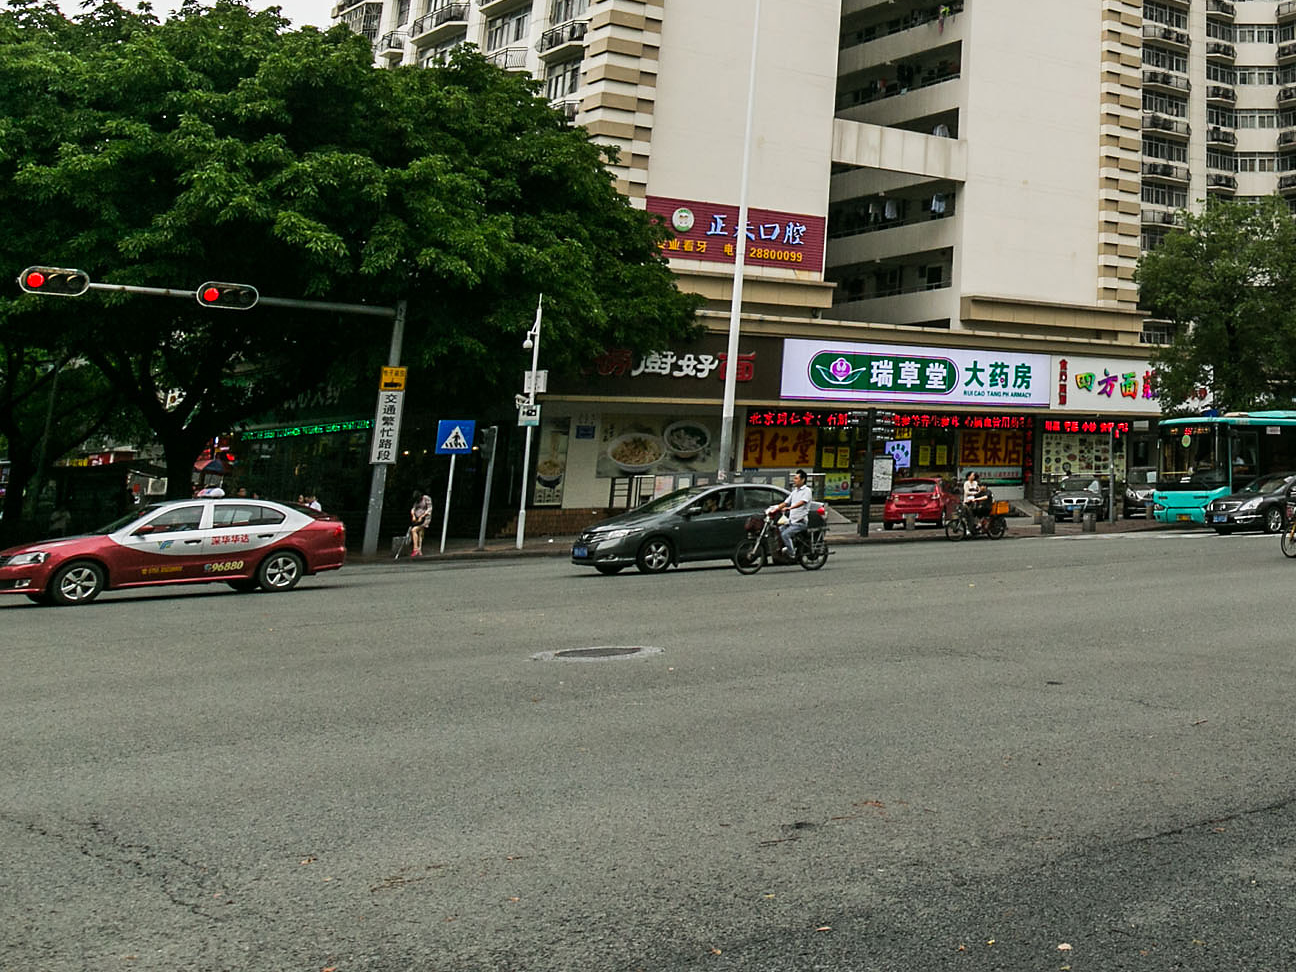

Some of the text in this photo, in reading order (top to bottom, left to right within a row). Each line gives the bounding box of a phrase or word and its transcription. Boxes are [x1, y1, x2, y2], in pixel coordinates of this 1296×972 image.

[750, 247, 803, 263] 28800099
[869, 359, 948, 389] 瑞草堂
[963, 360, 1033, 390] 大药房
[376, 393, 398, 461] 交通繁忙路段
[744, 428, 816, 466] 同仁堂
[961, 431, 1024, 464] 医保店
[211, 560, 244, 572] 96880
